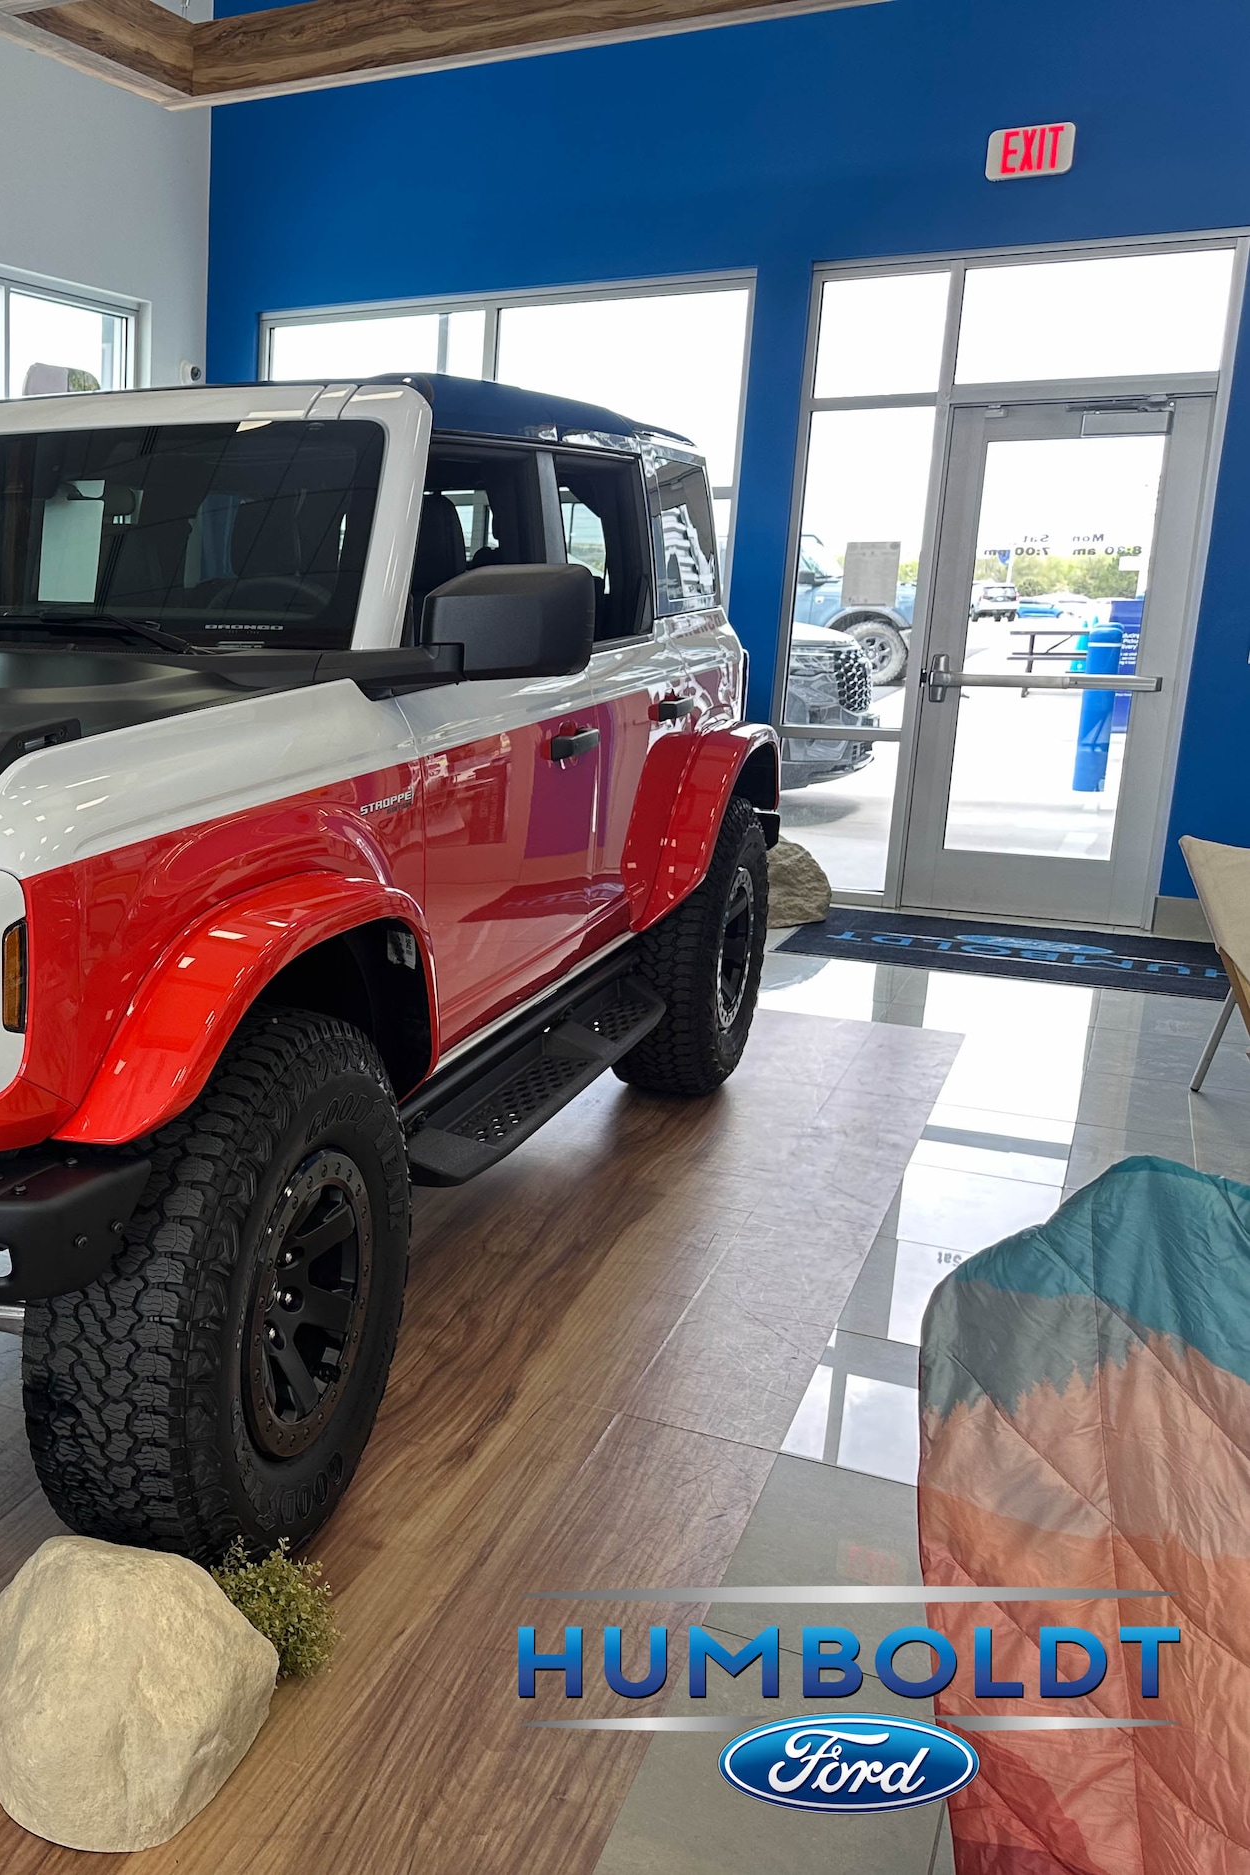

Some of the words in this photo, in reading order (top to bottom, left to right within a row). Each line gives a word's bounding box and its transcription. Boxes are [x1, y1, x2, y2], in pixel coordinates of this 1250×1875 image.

[1001, 125, 1065, 174] EXIT
[360, 791, 412, 816] STROPPE
[937, 1251, 962, 1267] Sat
